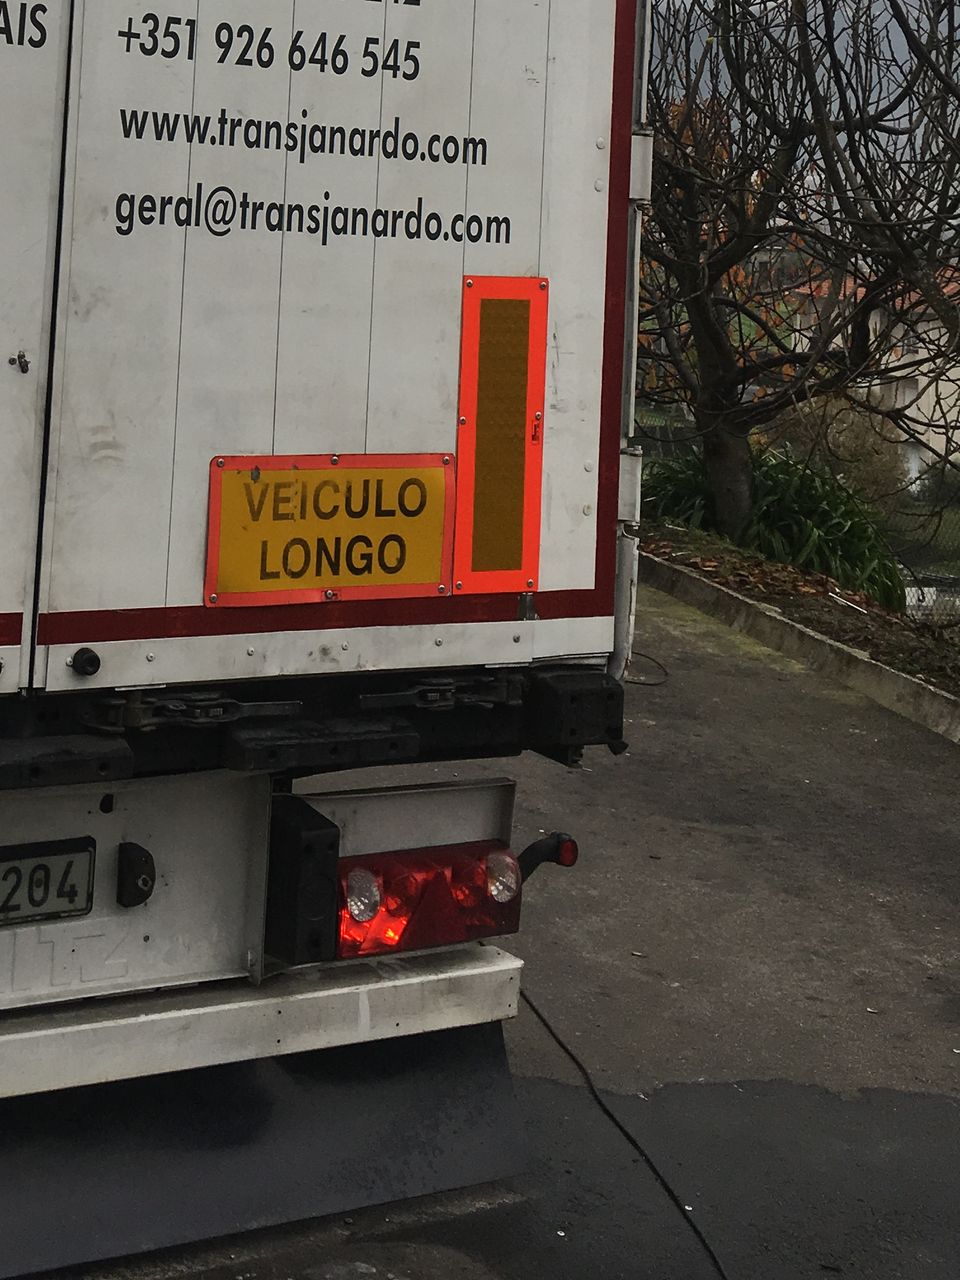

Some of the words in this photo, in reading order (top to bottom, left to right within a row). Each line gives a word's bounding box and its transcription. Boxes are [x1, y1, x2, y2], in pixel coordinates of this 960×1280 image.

[117, 12, 197, 61] +351
[214, 21, 276, 69] 926
[287, 30, 349, 75] 646
[360, 36, 421, 81] 545
[119, 107, 488, 166] www.transjanardo.com
[115, 182, 511, 246] geral@transjanardo.com
[243, 477, 427, 522] VEICULO
[259, 533, 407, 581] LONGO
